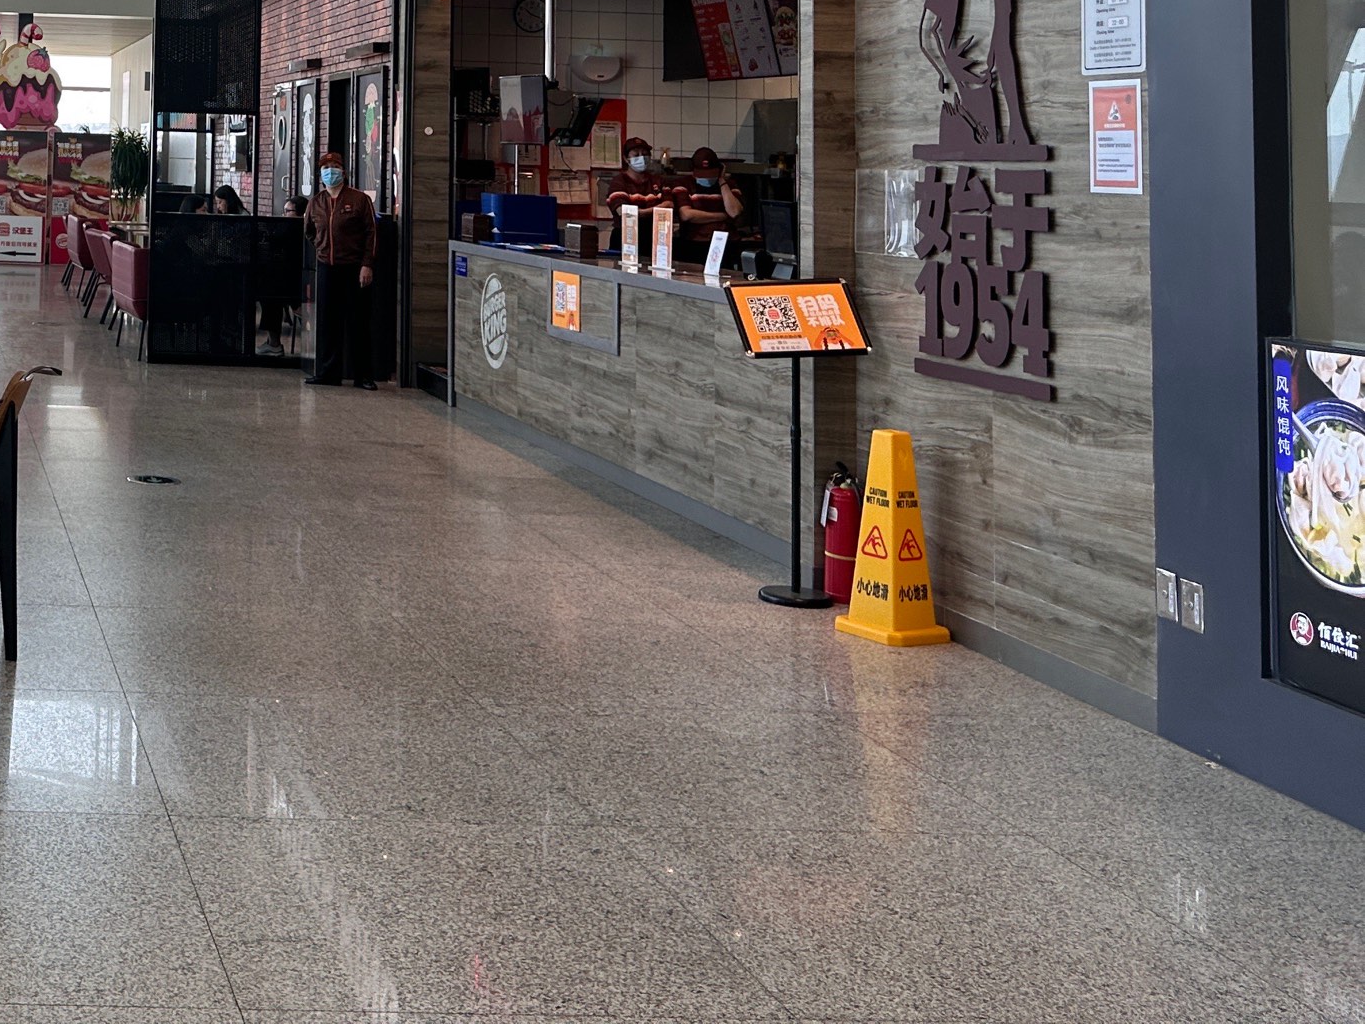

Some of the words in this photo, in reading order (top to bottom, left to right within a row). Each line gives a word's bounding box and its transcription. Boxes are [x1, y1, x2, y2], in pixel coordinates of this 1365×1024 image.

[914, 166, 1049, 272] 始于
[914, 261, 1049, 377] 1954
[1275, 375, 1291, 456] 风味馄饨
[866, 495, 875, 505] WET
[876, 497, 889, 508] FLOOR
[869, 487, 887, 498] CAUTION
[896, 500, 906, 508] WET
[906, 499, 918, 508] FLOOR
[857, 577, 889, 601] 小心地滑
[899, 584, 928, 602] 小心地滑
